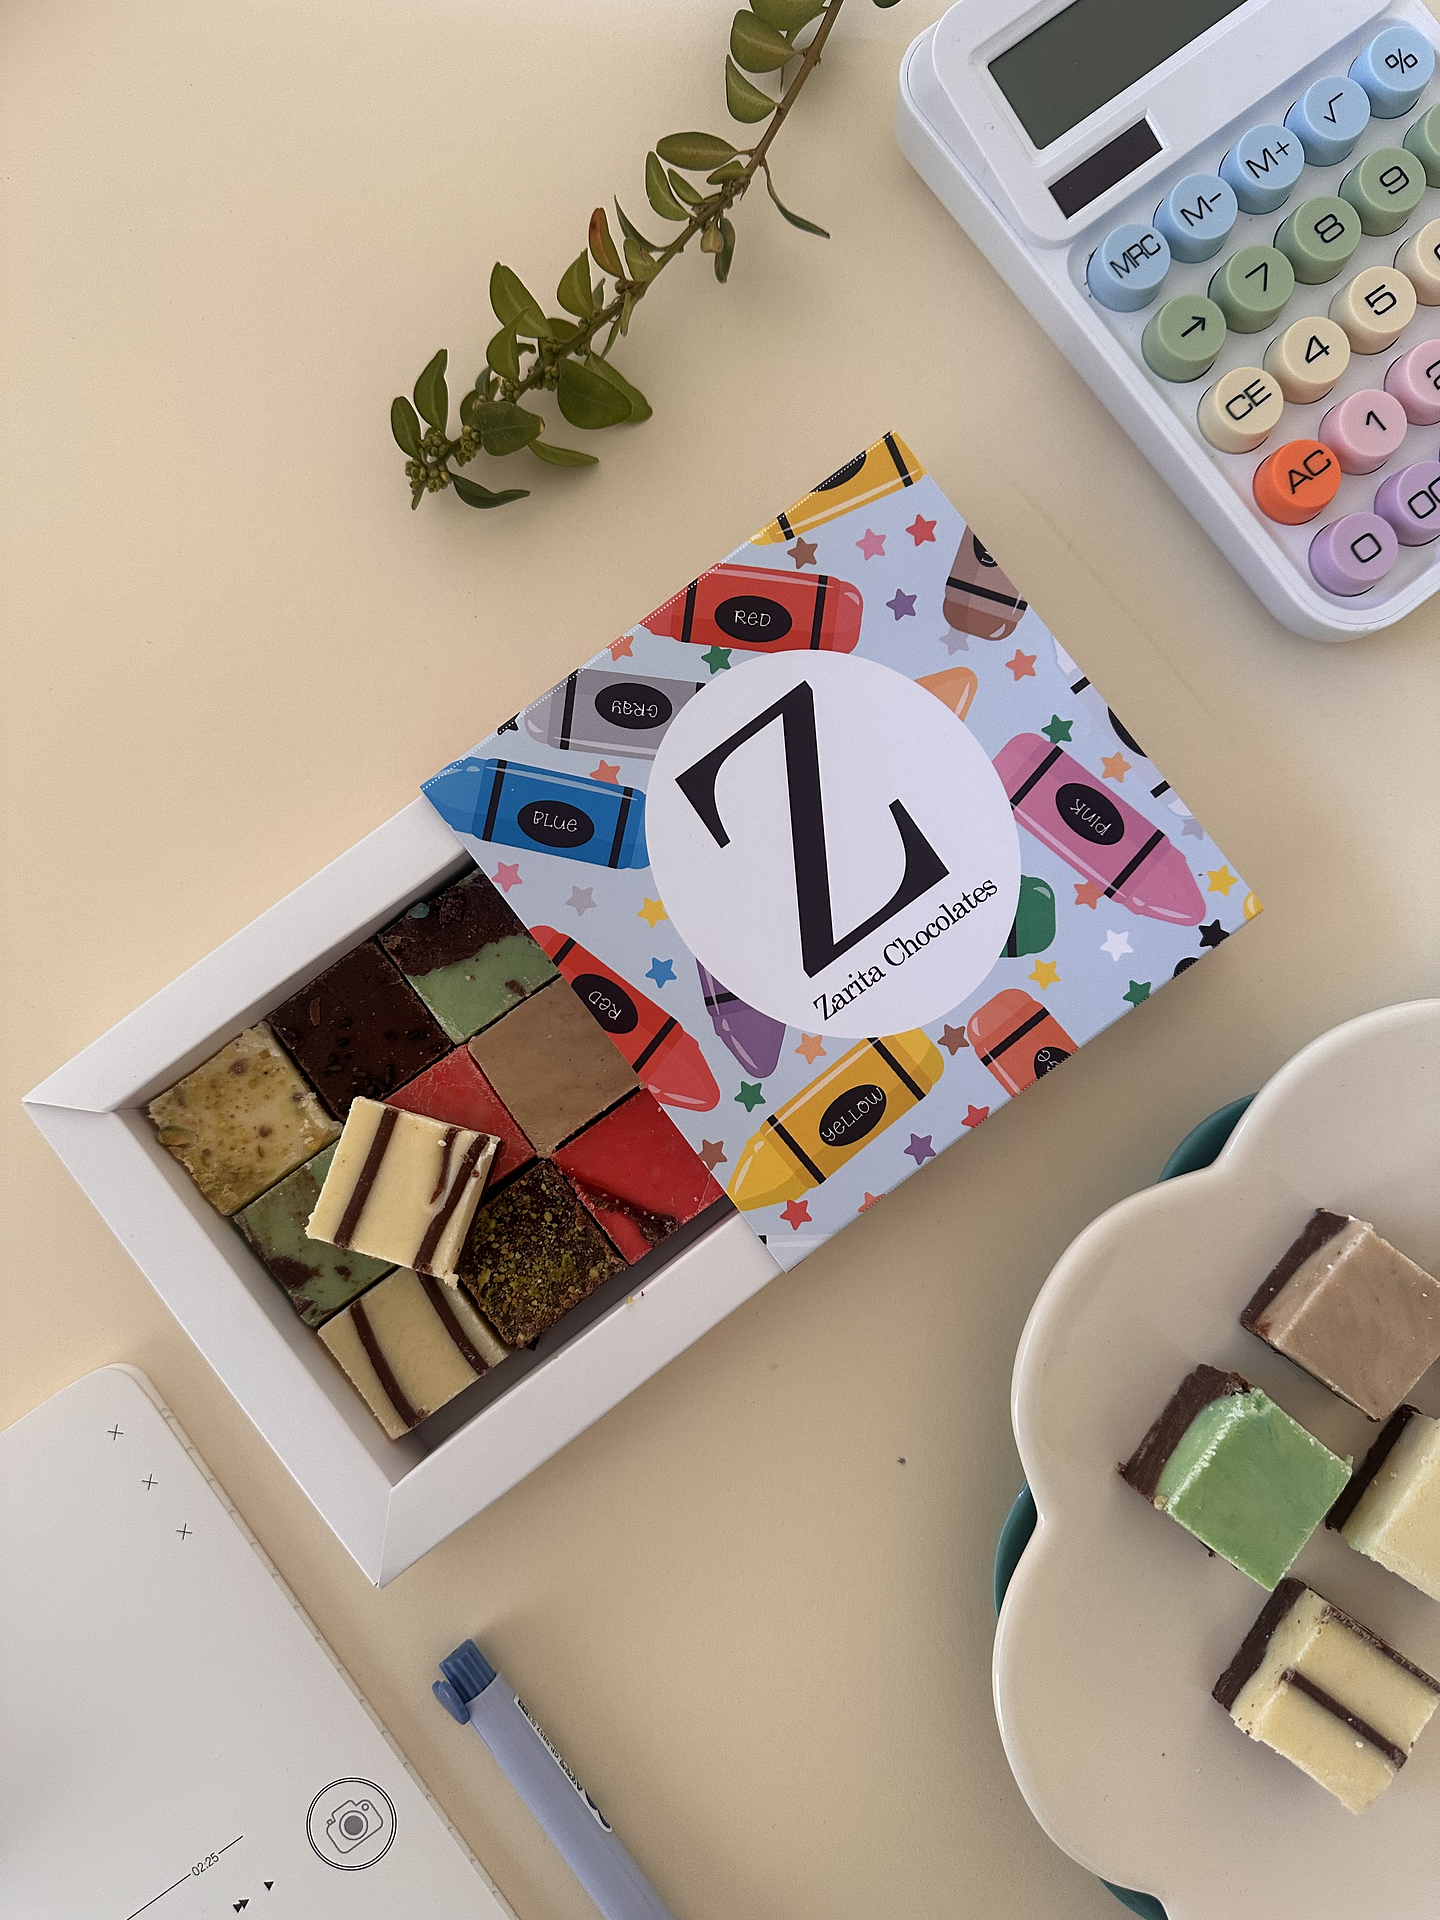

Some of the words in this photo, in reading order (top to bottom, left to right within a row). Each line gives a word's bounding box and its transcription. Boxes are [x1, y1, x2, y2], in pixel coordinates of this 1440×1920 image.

[1245, 141, 1291, 179] M+
[1379, 165, 1410, 195] 9
[1180, 192, 1222, 226] M-
[1313, 213, 1345, 244] 8
[1109, 233, 1162, 279] MRC
[1245, 262, 1269, 292] 7
[1364, 284, 1397, 316] 5
[1304, 335, 1330, 364] 4
[1225, 378, 1273, 421] CE
[1365, 410, 1387, 432] 1
[1287, 449, 1332, 495] AC
[1350, 532, 1383, 564] 0
[674, 680, 950, 979] Z
[812, 965, 887, 1021] Zarita
[882, 878, 999, 967] Chocolates
[191, 1852, 220, 1876] 02:25
